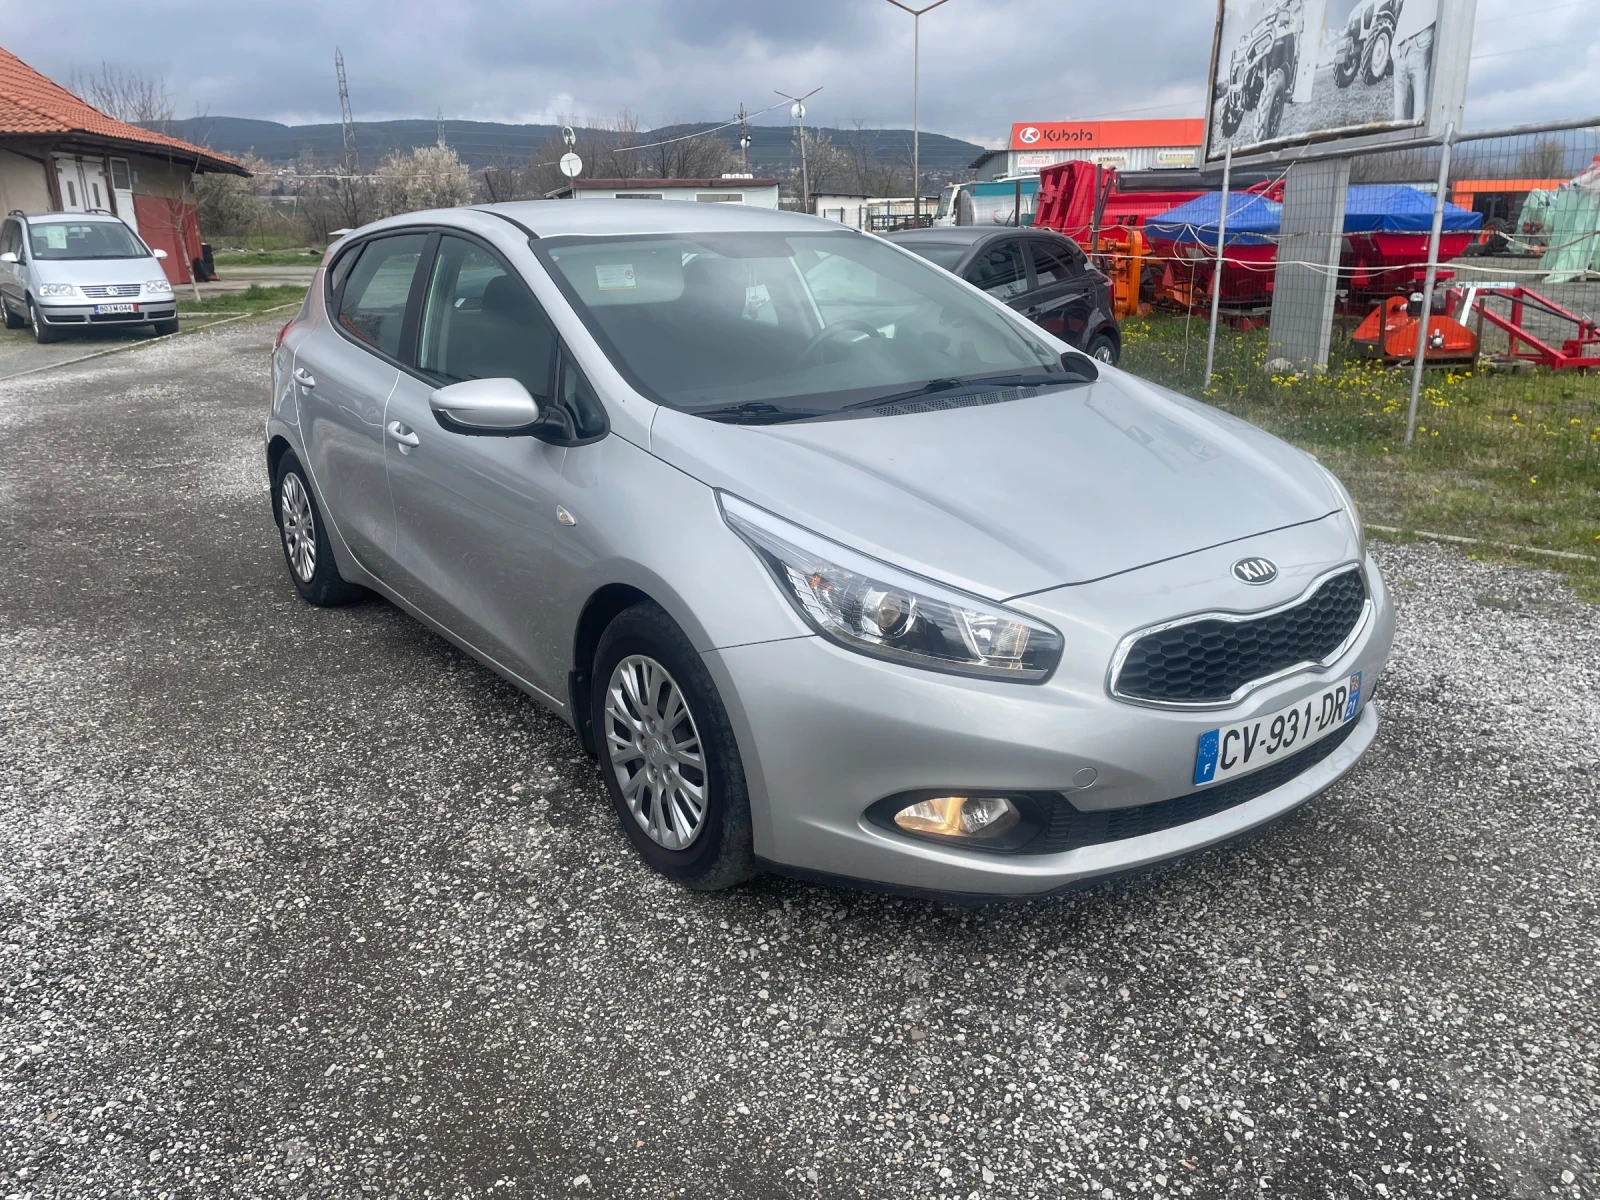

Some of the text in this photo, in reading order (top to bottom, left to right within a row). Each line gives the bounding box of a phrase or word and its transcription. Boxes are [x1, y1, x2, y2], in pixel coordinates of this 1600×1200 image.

[1043, 128, 1093, 142] Kubota
[1116, 214, 1139, 226] T8
[1237, 559, 1275, 580] KIA
[1345, 698, 1356, 717] 21
[1220, 685, 1347, 770] CV-931-DR
[1203, 763, 1211, 774] F
